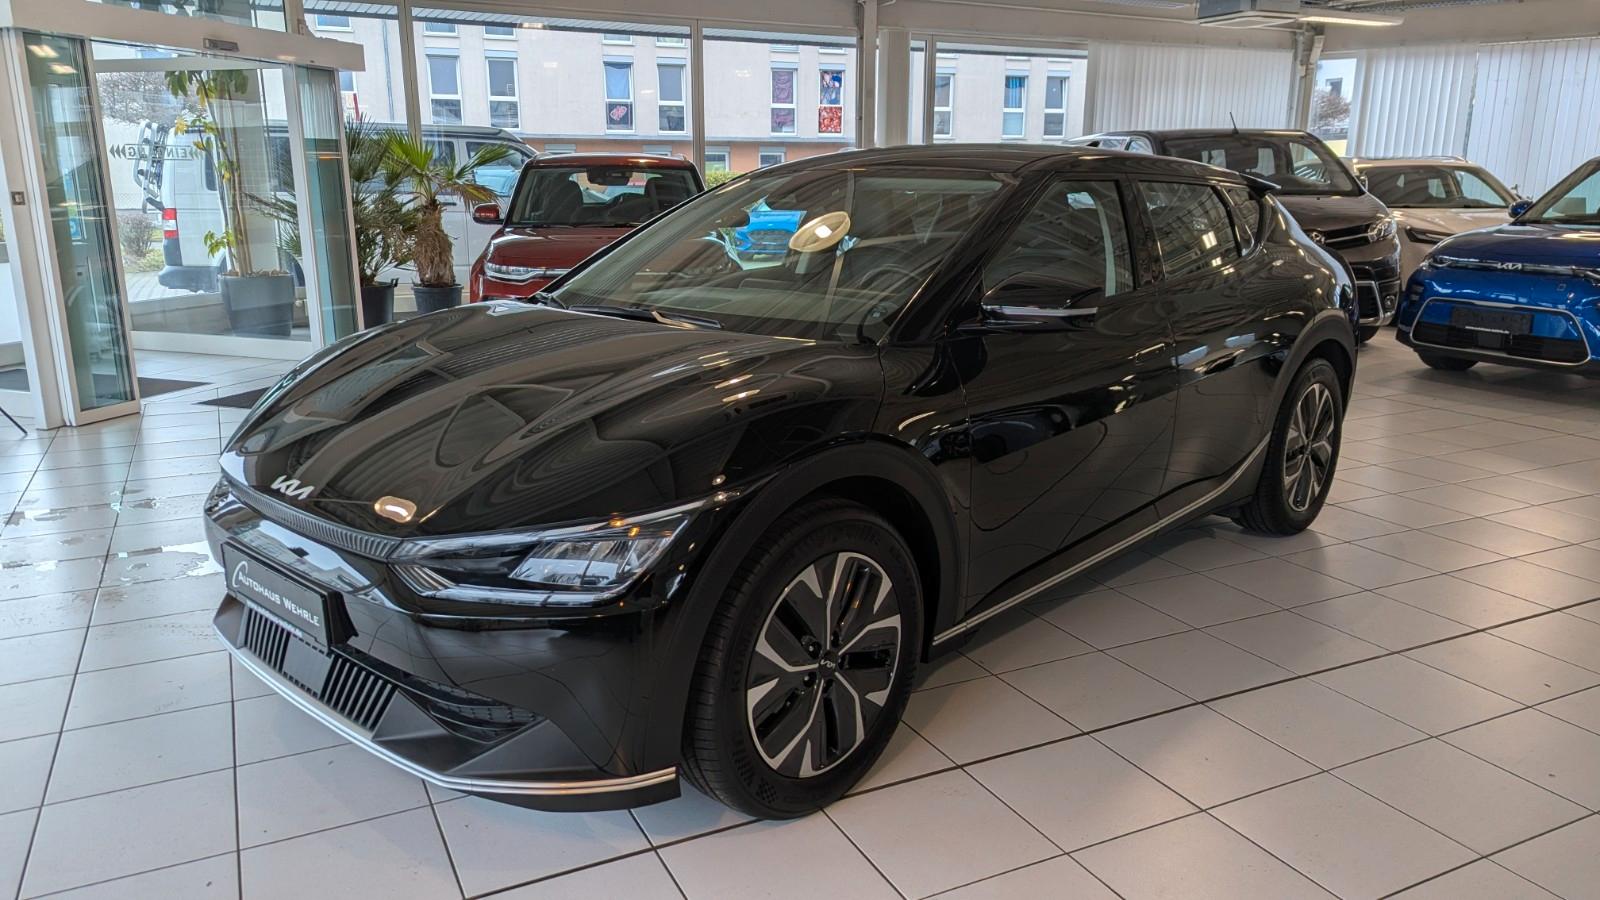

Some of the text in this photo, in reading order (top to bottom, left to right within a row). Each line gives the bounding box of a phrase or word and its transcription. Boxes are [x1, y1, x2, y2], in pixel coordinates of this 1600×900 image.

[270, 475, 315, 500] KIA
[238, 570, 281, 605] AUTOHAUS
[282, 596, 320, 627] WEHRLE
